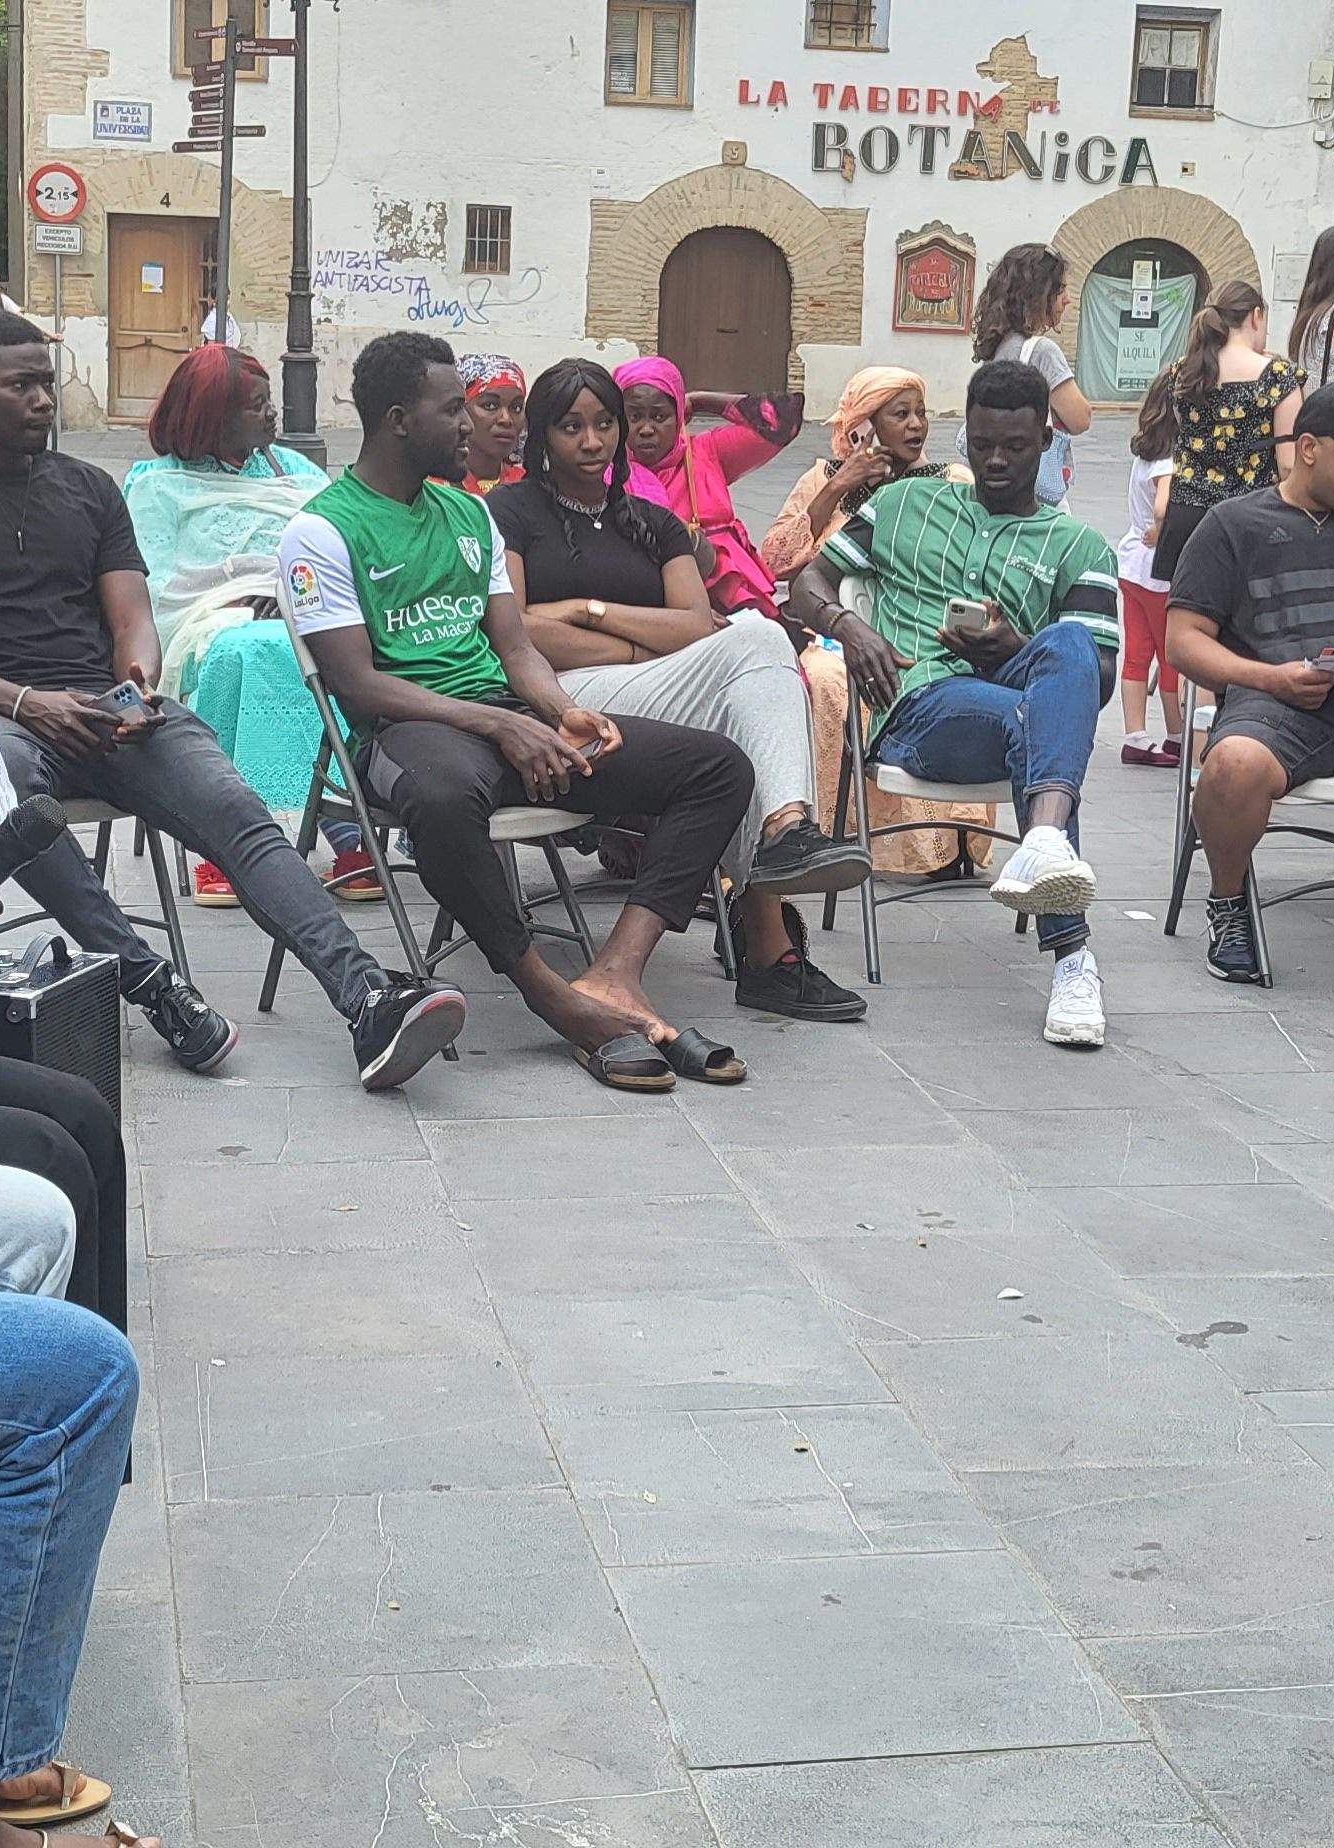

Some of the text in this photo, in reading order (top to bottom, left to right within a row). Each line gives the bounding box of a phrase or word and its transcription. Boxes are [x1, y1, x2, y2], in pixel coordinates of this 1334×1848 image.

[738, 79, 788, 107] LA
[812, 82, 1004, 122] TABERNA
[116, 106, 142, 115] PLAZA
[96, 122, 150, 136] UNIVERSIDAD
[159, 192, 172, 208] 4
[316, 250, 392, 272] UNIZAR
[313, 270, 431, 297] ANTIFASCISTA
[1134, 331, 1145, 342] SE
[1122, 347, 1156, 361] ALQUILA
